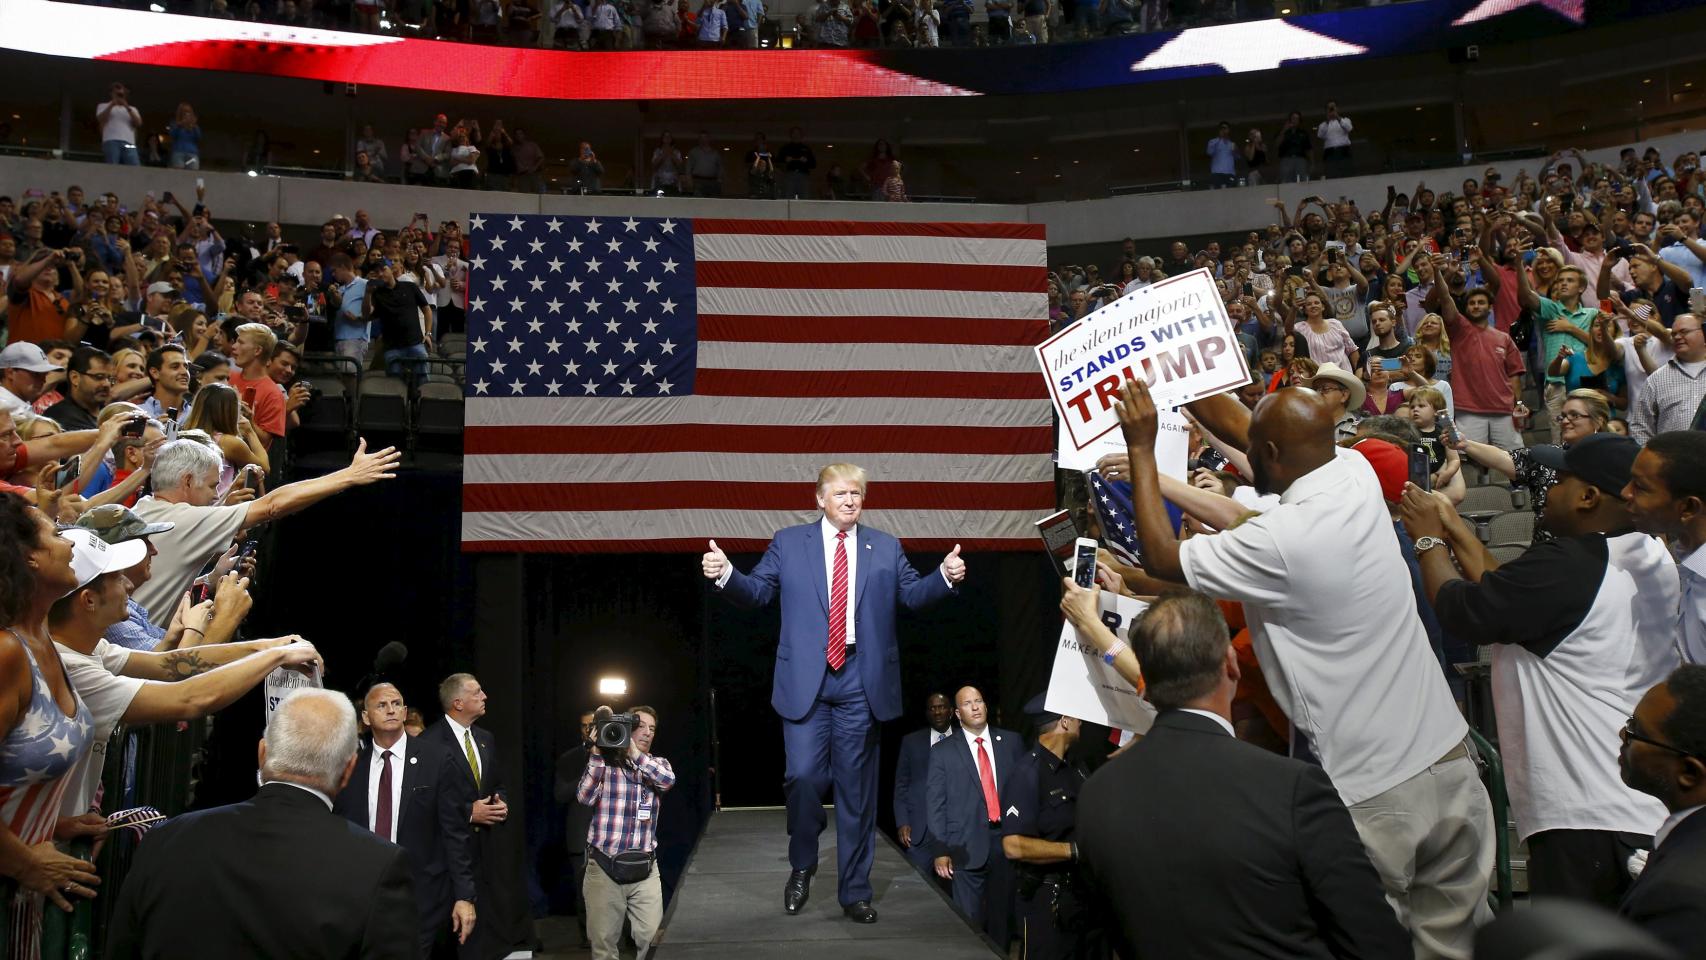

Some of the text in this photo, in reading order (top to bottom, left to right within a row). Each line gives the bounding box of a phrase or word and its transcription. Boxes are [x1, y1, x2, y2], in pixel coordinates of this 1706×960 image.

[1054, 288, 1206, 371] the silent majority
[1059, 310, 1218, 392] STANDS WITH
[1066, 335, 1227, 424] TRUMP
[1061, 639, 1092, 655] MAKE
